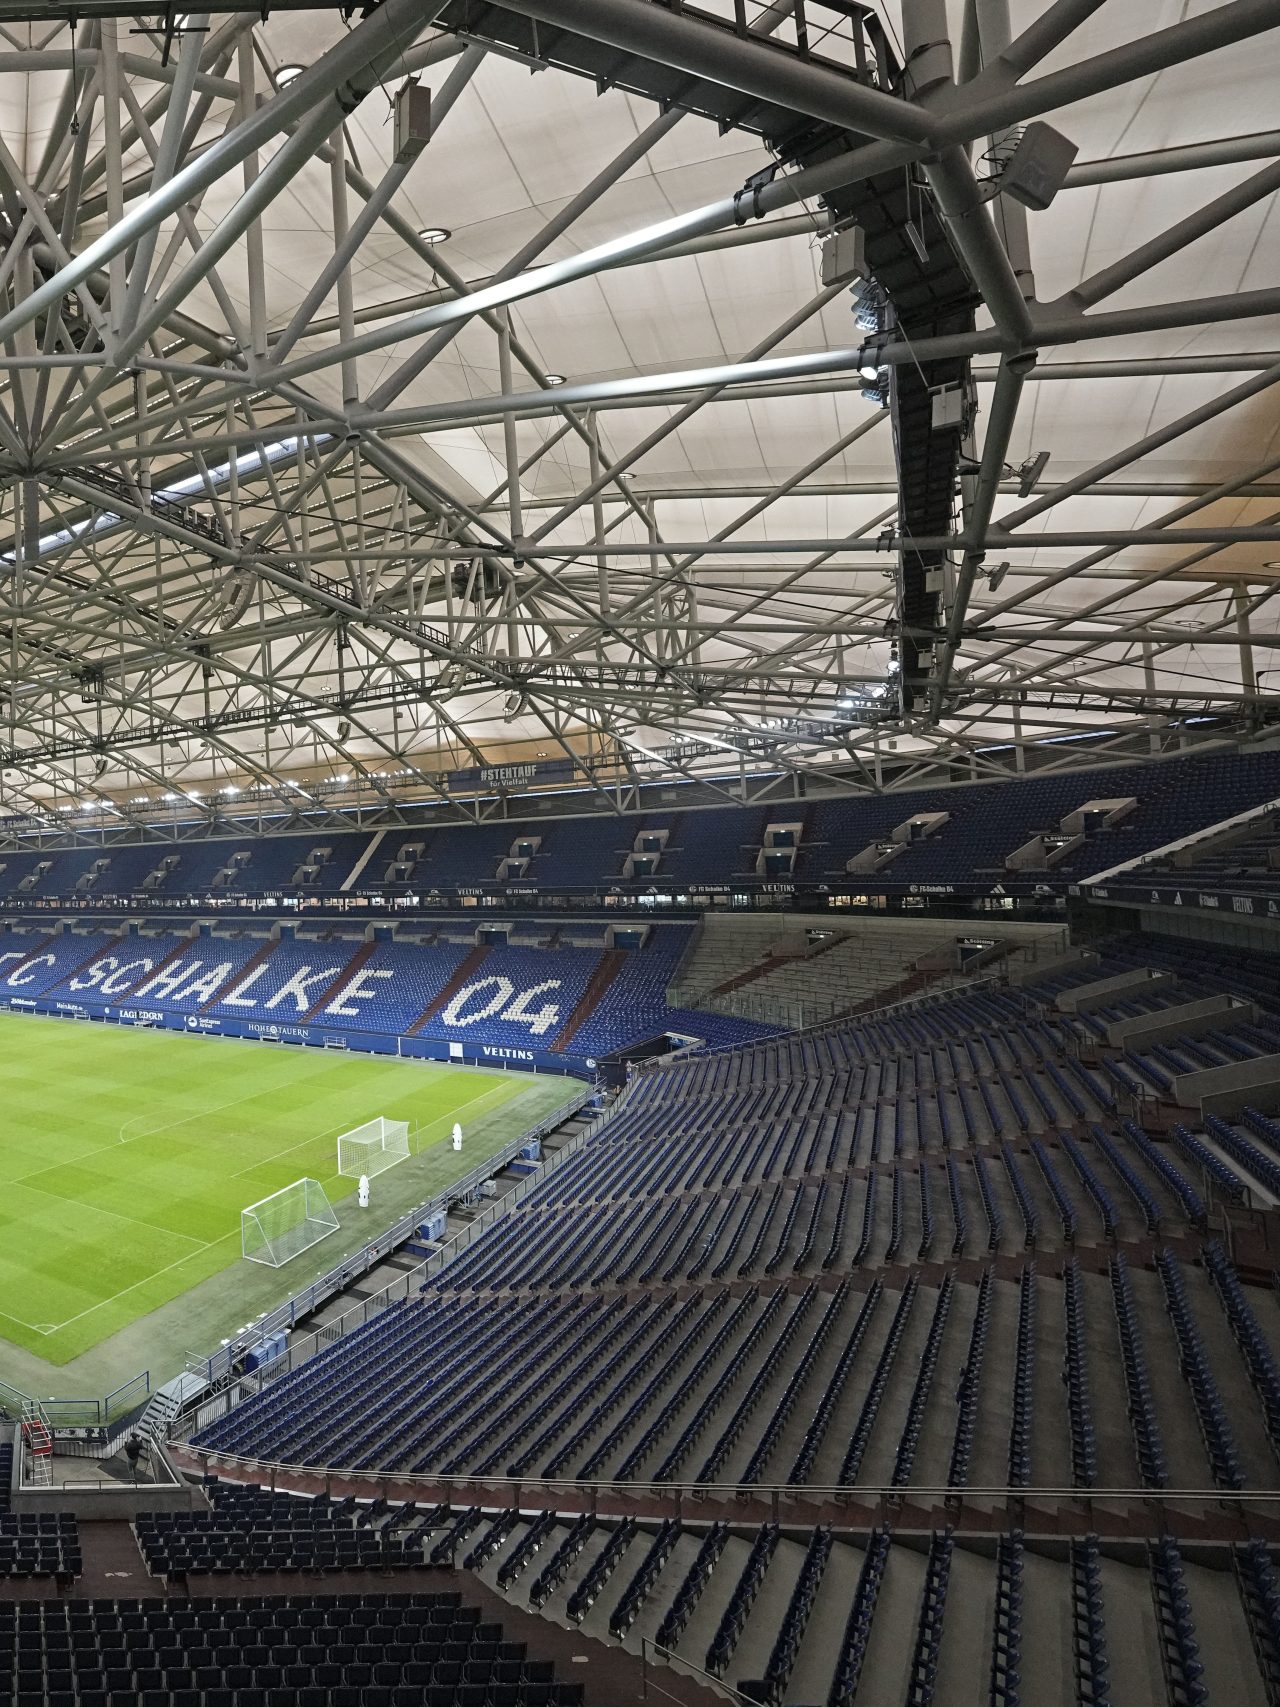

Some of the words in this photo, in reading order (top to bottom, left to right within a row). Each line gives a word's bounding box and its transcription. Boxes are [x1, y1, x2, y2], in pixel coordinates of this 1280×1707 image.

[480, 764, 537, 781] #STEHTAUF
[490, 779, 500, 787] für
[501, 778, 528, 787] Vielfalt
[762, 884, 795, 892] VELTINS
[1232, 896, 1253, 914] VELTINS
[69, 956, 394, 1017] SCHALKE
[441, 975, 561, 1035] 04
[248, 1023, 270, 1033] HOHE
[277, 1027, 310, 1038] TAUERN
[483, 1046, 534, 1060] VELTINS
